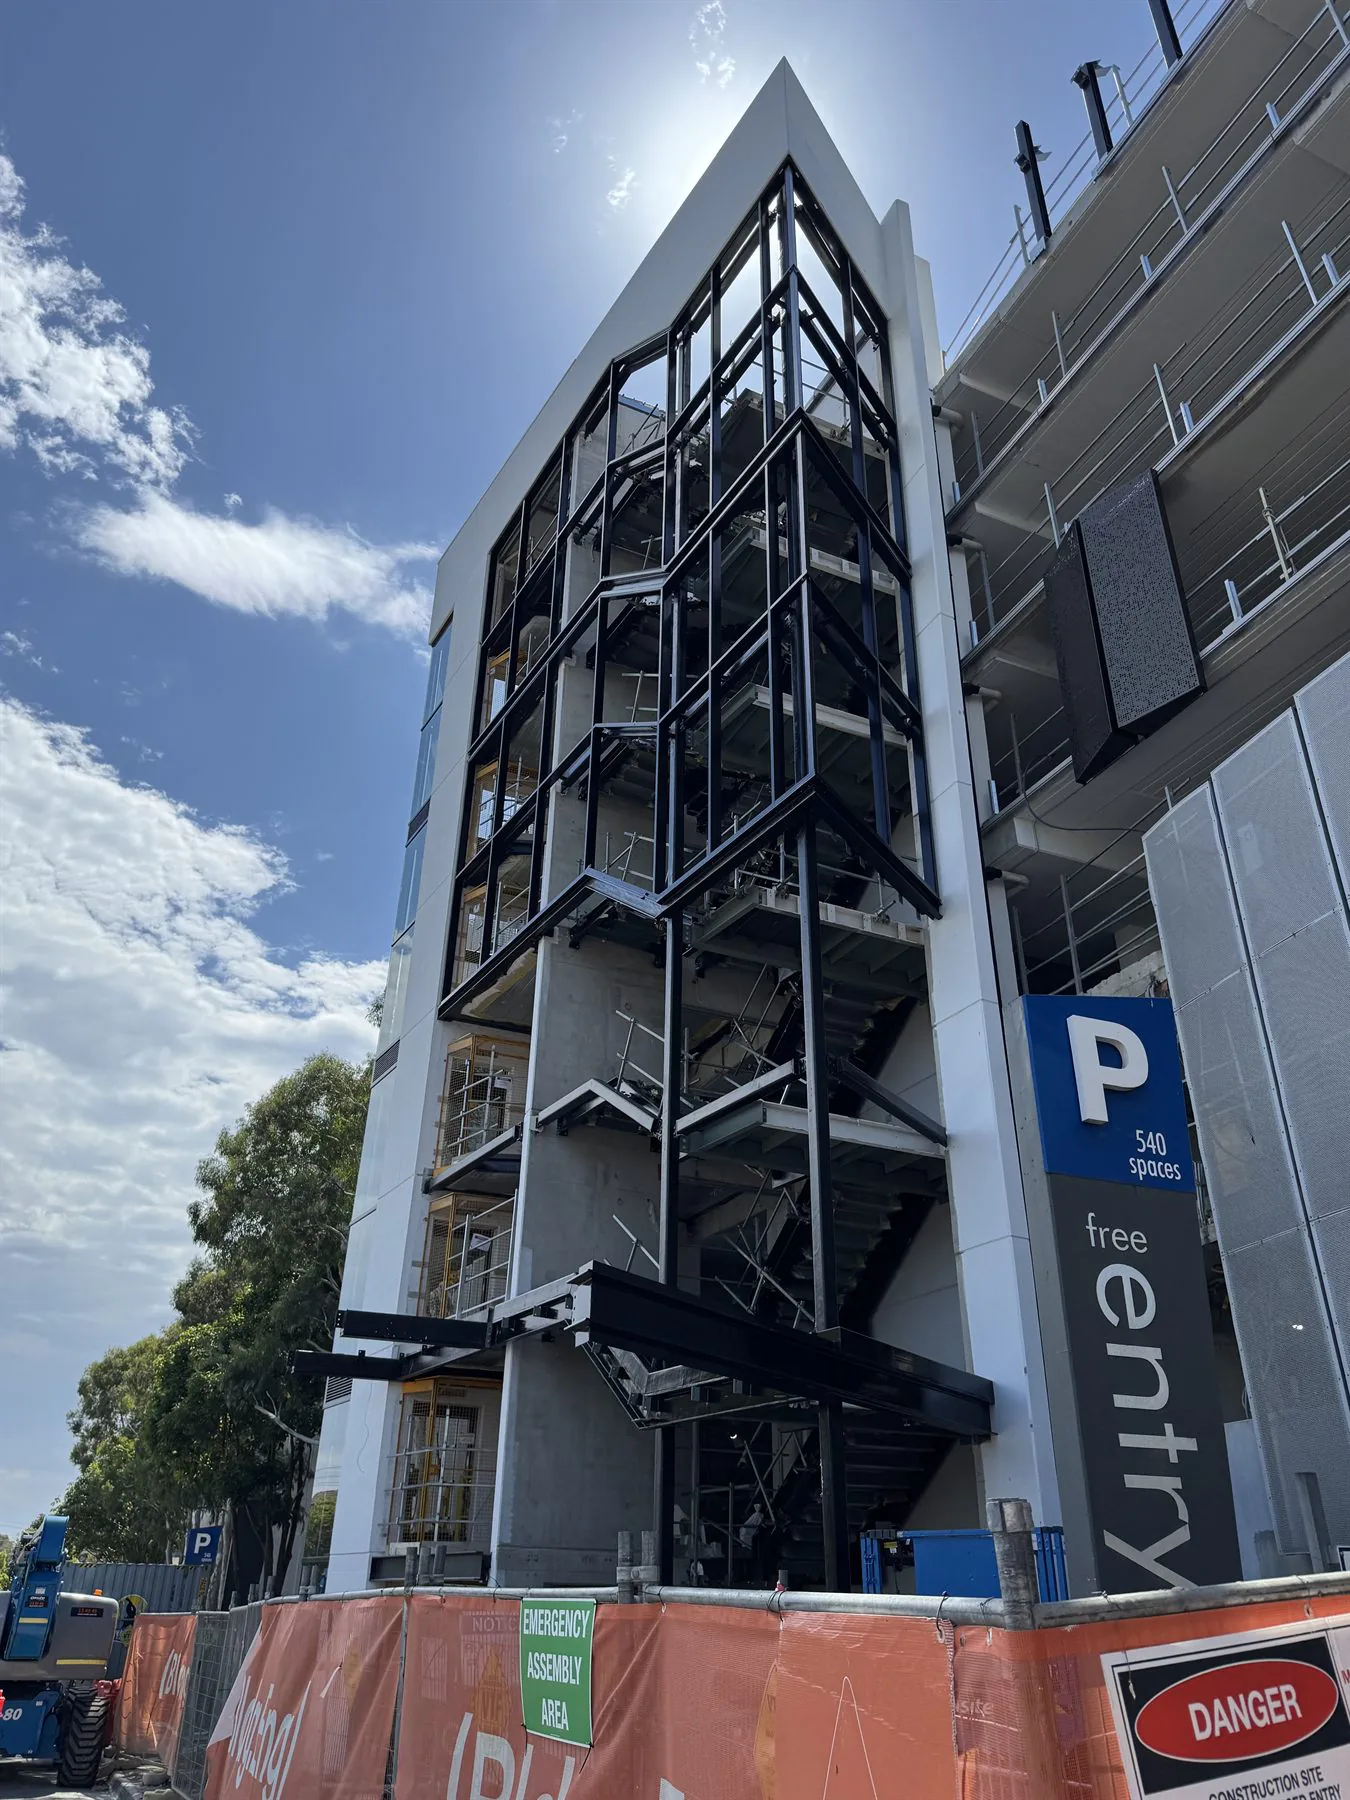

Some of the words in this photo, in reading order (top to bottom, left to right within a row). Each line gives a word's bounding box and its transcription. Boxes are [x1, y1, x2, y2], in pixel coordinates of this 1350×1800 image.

[1066, 1014, 1149, 1125] P
[1135, 1129, 1167, 1156] 540
[1129, 1156, 1182, 1181] spaces
[1085, 1212, 1148, 1254] free
[1096, 1263, 1200, 1590] entry
[193, 1532, 212, 1554] P
[523, 1608, 590, 1638] EMERGENCY
[527, 1651, 582, 1685] ASSEMBLY
[541, 1698, 569, 1731] AREA
[1188, 1683, 1302, 1741] DANGER
[1300, 1766, 1324, 1786] SITE
